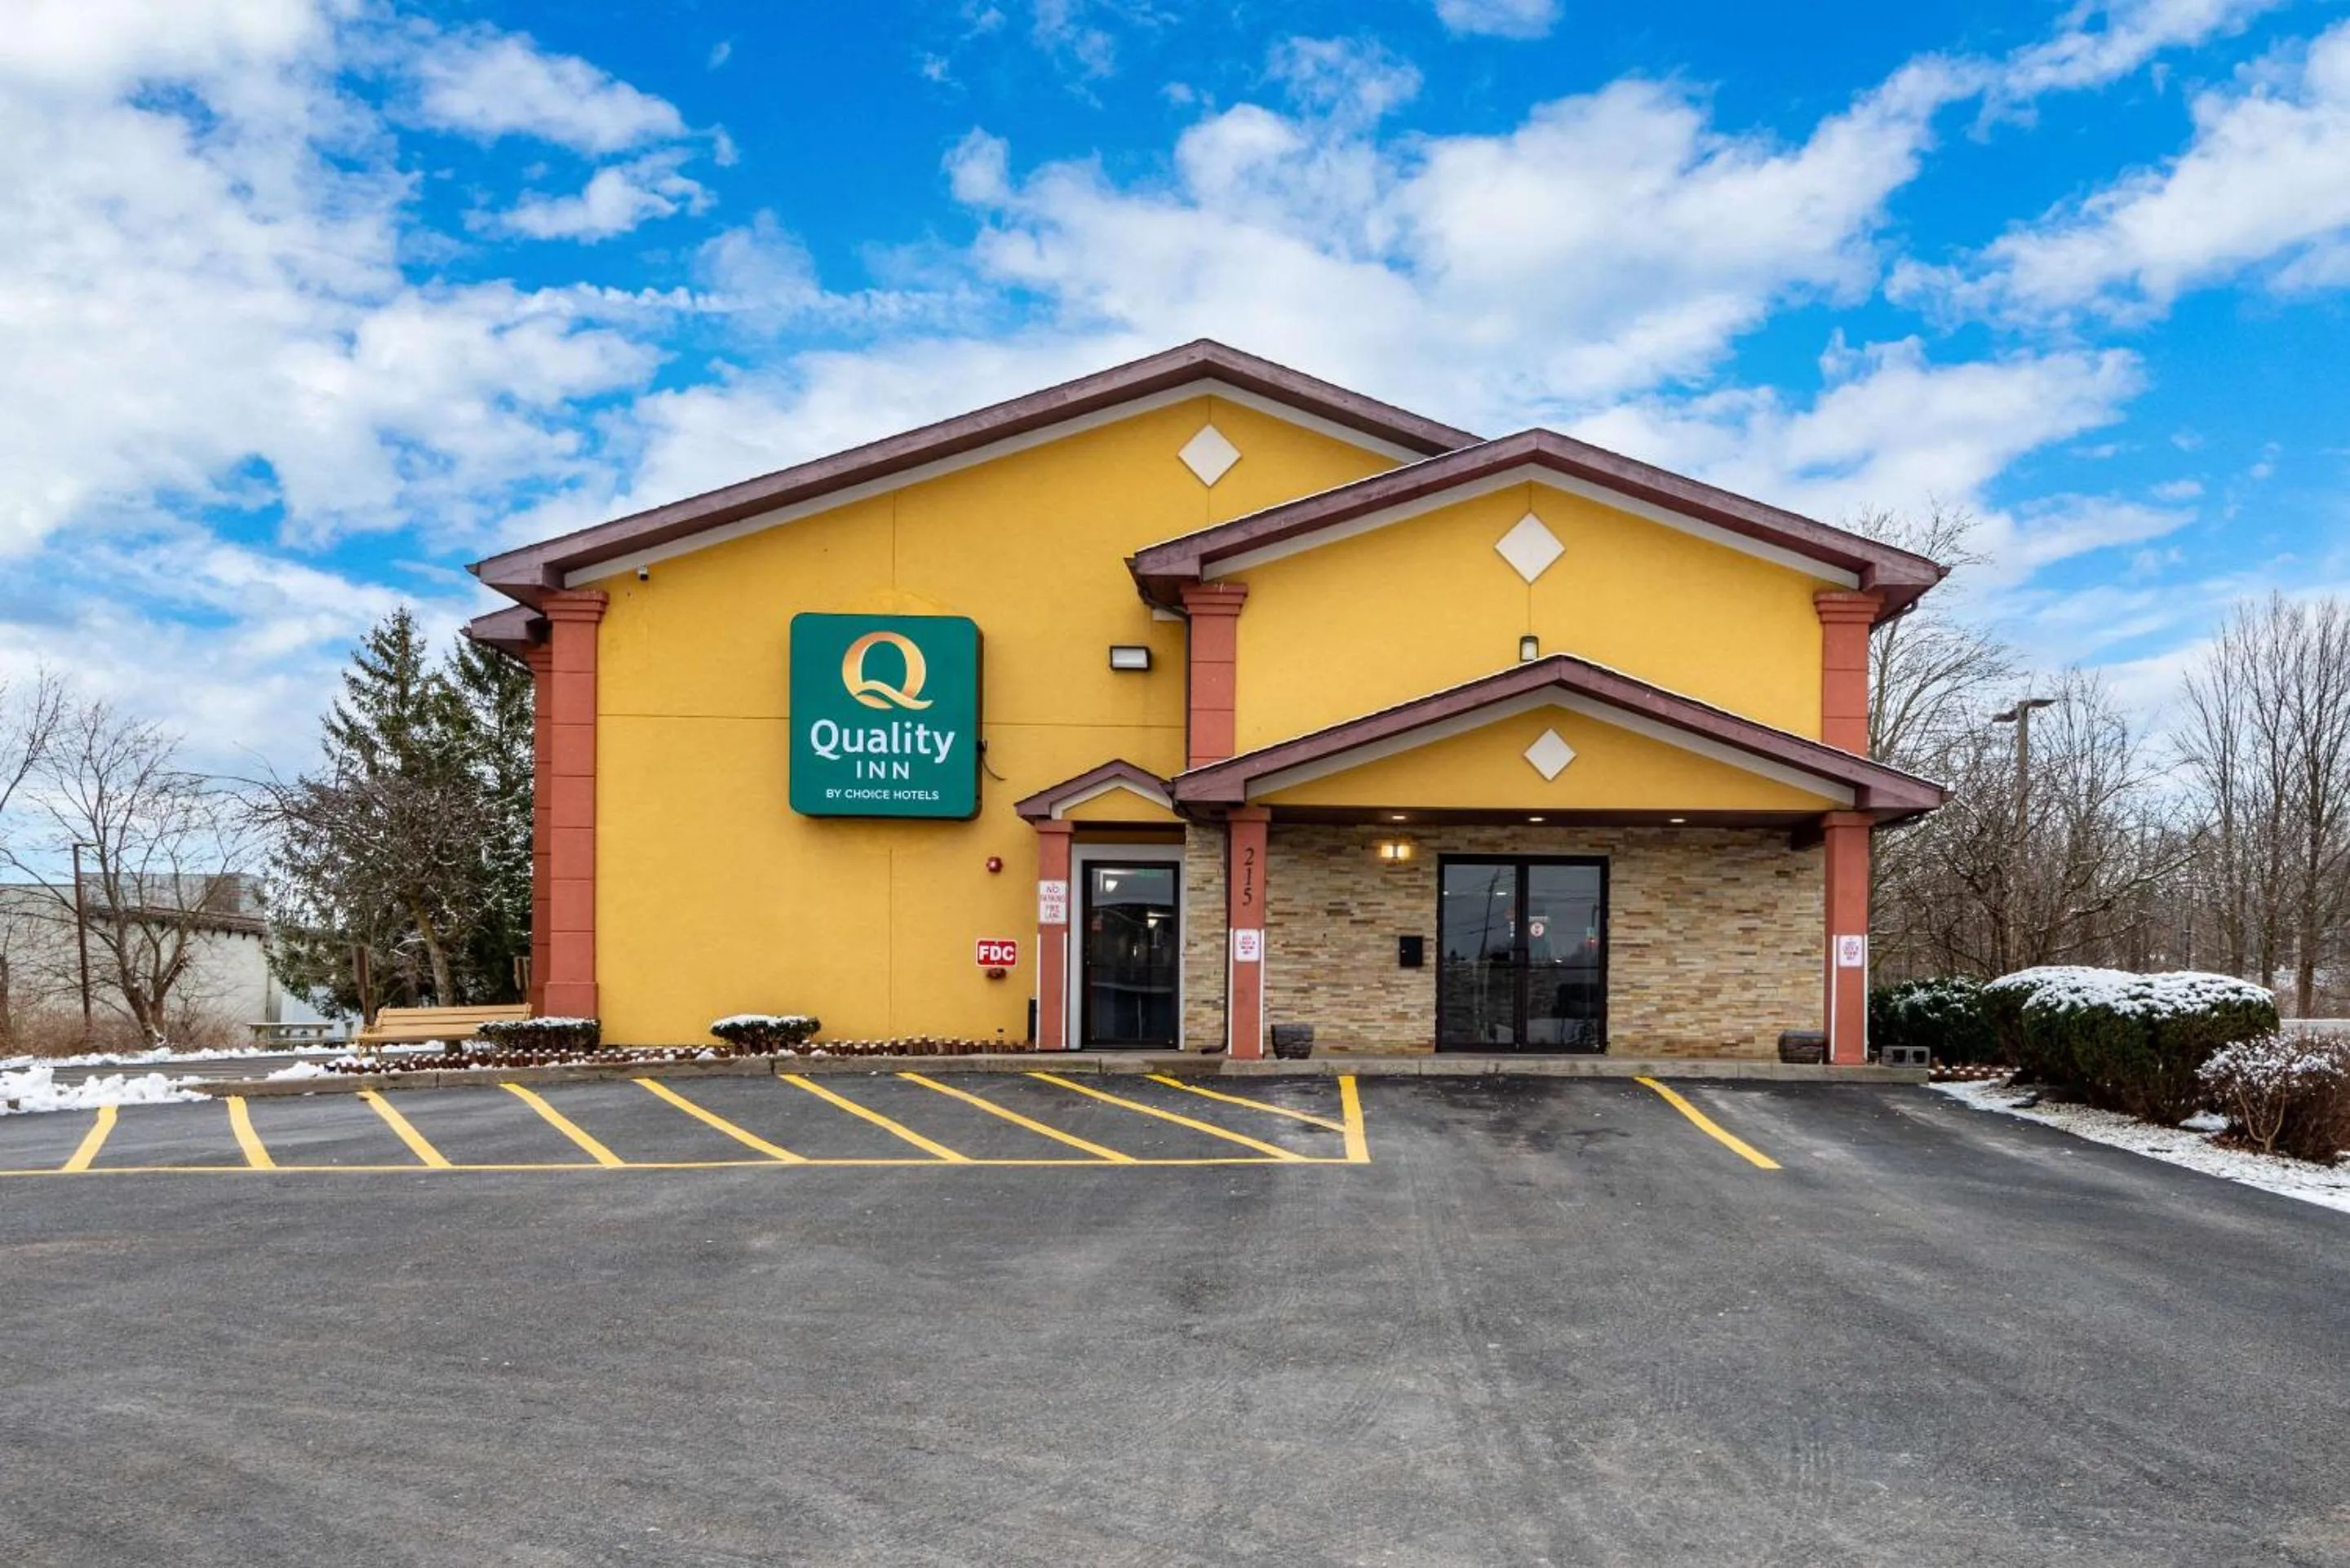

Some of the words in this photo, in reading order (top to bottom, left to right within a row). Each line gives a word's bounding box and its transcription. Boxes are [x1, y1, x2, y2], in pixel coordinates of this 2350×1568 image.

[842, 631, 933, 710] Q
[811, 719, 956, 764] Quality
[857, 760, 910, 780] INN
[826, 788, 841, 799] BY
[845, 789, 889, 800] CHOICE
[894, 790, 939, 800] HOTELS
[1242, 847, 1254, 906] 215
[979, 945, 1014, 961] FDC
